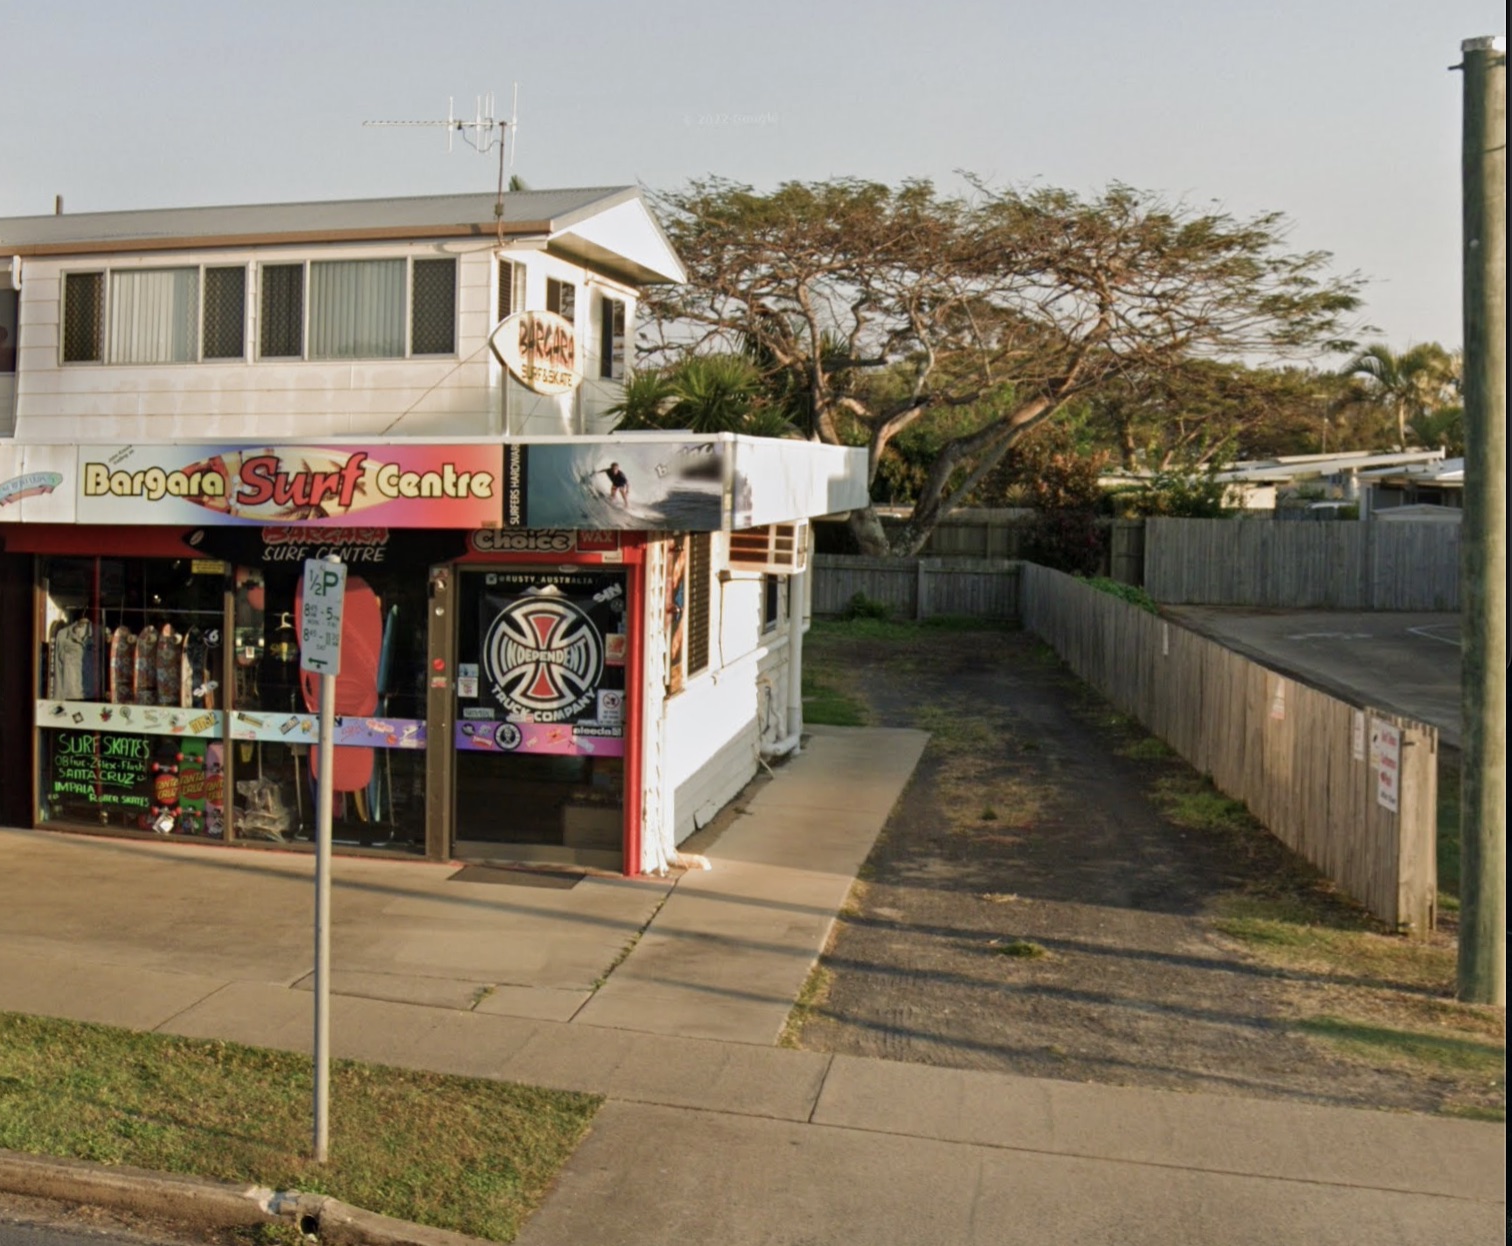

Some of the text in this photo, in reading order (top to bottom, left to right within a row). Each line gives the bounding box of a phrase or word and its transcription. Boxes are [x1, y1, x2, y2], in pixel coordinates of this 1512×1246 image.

[519, 319, 575, 369] BARGARA
[84, 462, 226, 501] Bargara
[239, 451, 369, 507] Surf
[375, 461, 496, 500] Centre
[509, 442, 521, 526] SURFERS HARDWAR
[262, 546, 387, 562] SURF CENTRE
[474, 529, 569, 550] Choice
[580, 531, 613, 543] WAX
[500, 636, 587, 676] INDEPENDENT
[491, 683, 532, 717] TRUCK
[533, 687, 596, 722] COMPANY
[58, 732, 150, 759] SURF SKATES
[58, 767, 135, 784] SANTA CRUZ
